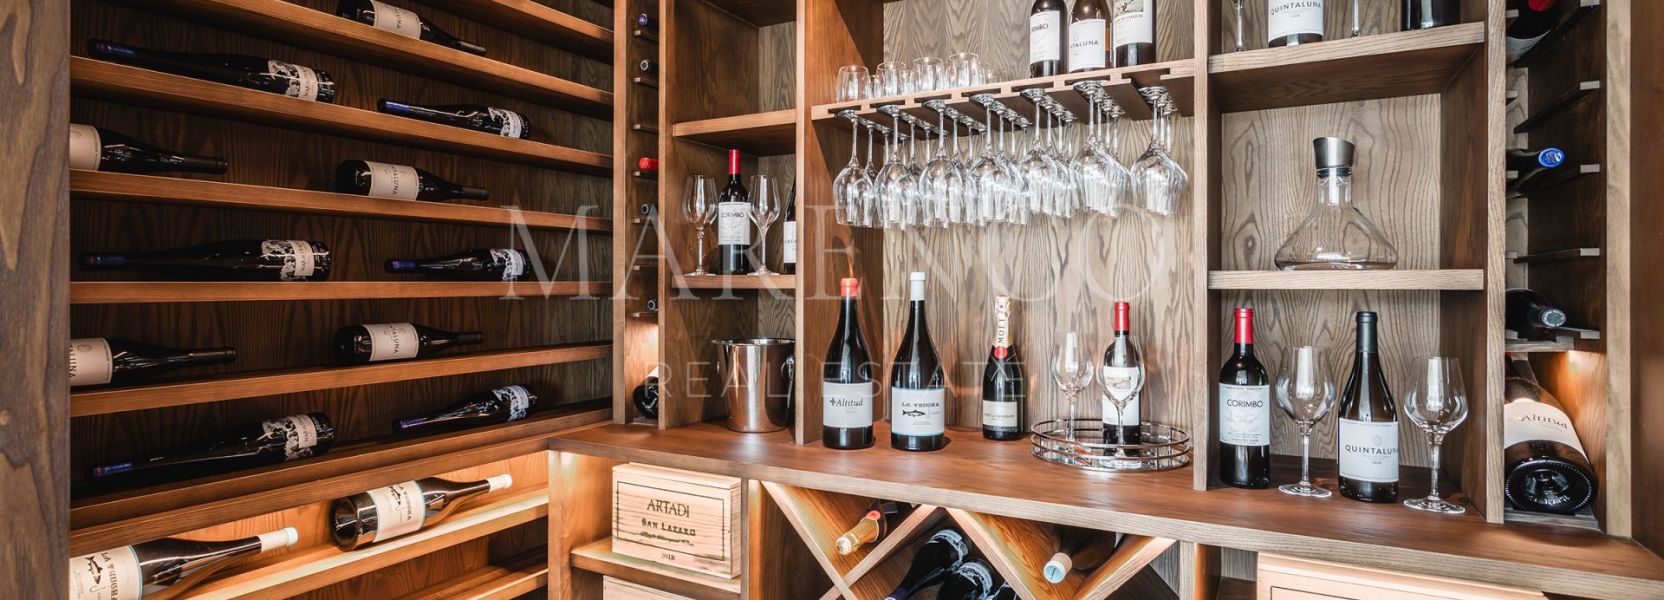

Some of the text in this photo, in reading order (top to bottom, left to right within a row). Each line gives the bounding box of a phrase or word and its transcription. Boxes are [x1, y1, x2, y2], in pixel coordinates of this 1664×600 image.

[1270, 0, 1322, 16] QUINTALUNA
[1226, 399, 1264, 408] CORIMBO
[1344, 444, 1400, 456] QUINTALUN
[646, 499, 690, 518] ARTADI
